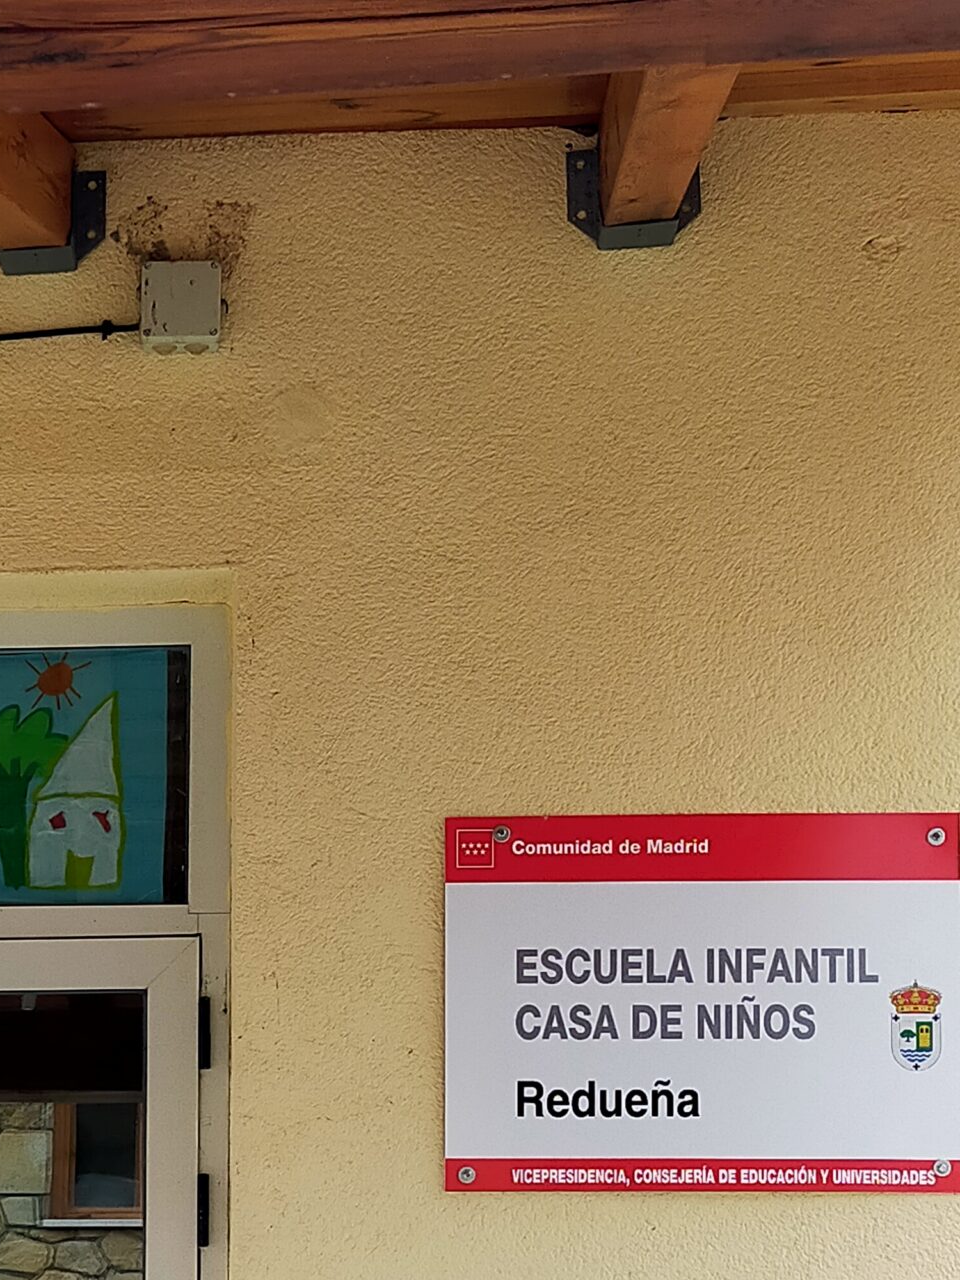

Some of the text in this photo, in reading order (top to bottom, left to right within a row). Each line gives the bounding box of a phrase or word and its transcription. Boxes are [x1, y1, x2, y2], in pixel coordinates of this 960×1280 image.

[511, 838, 709, 855] Comunidad de Madrid
[516, 948, 879, 985] ESCUELA INFANTIL
[515, 995, 816, 1040] CASA DE NIÑOS
[516, 1079, 700, 1118] Redueña
[512, 1165, 936, 1186] VICEPRESIDENCIA, CONSEJERÍA DE EDUCACIÓN Y UNIVERSIDADES
